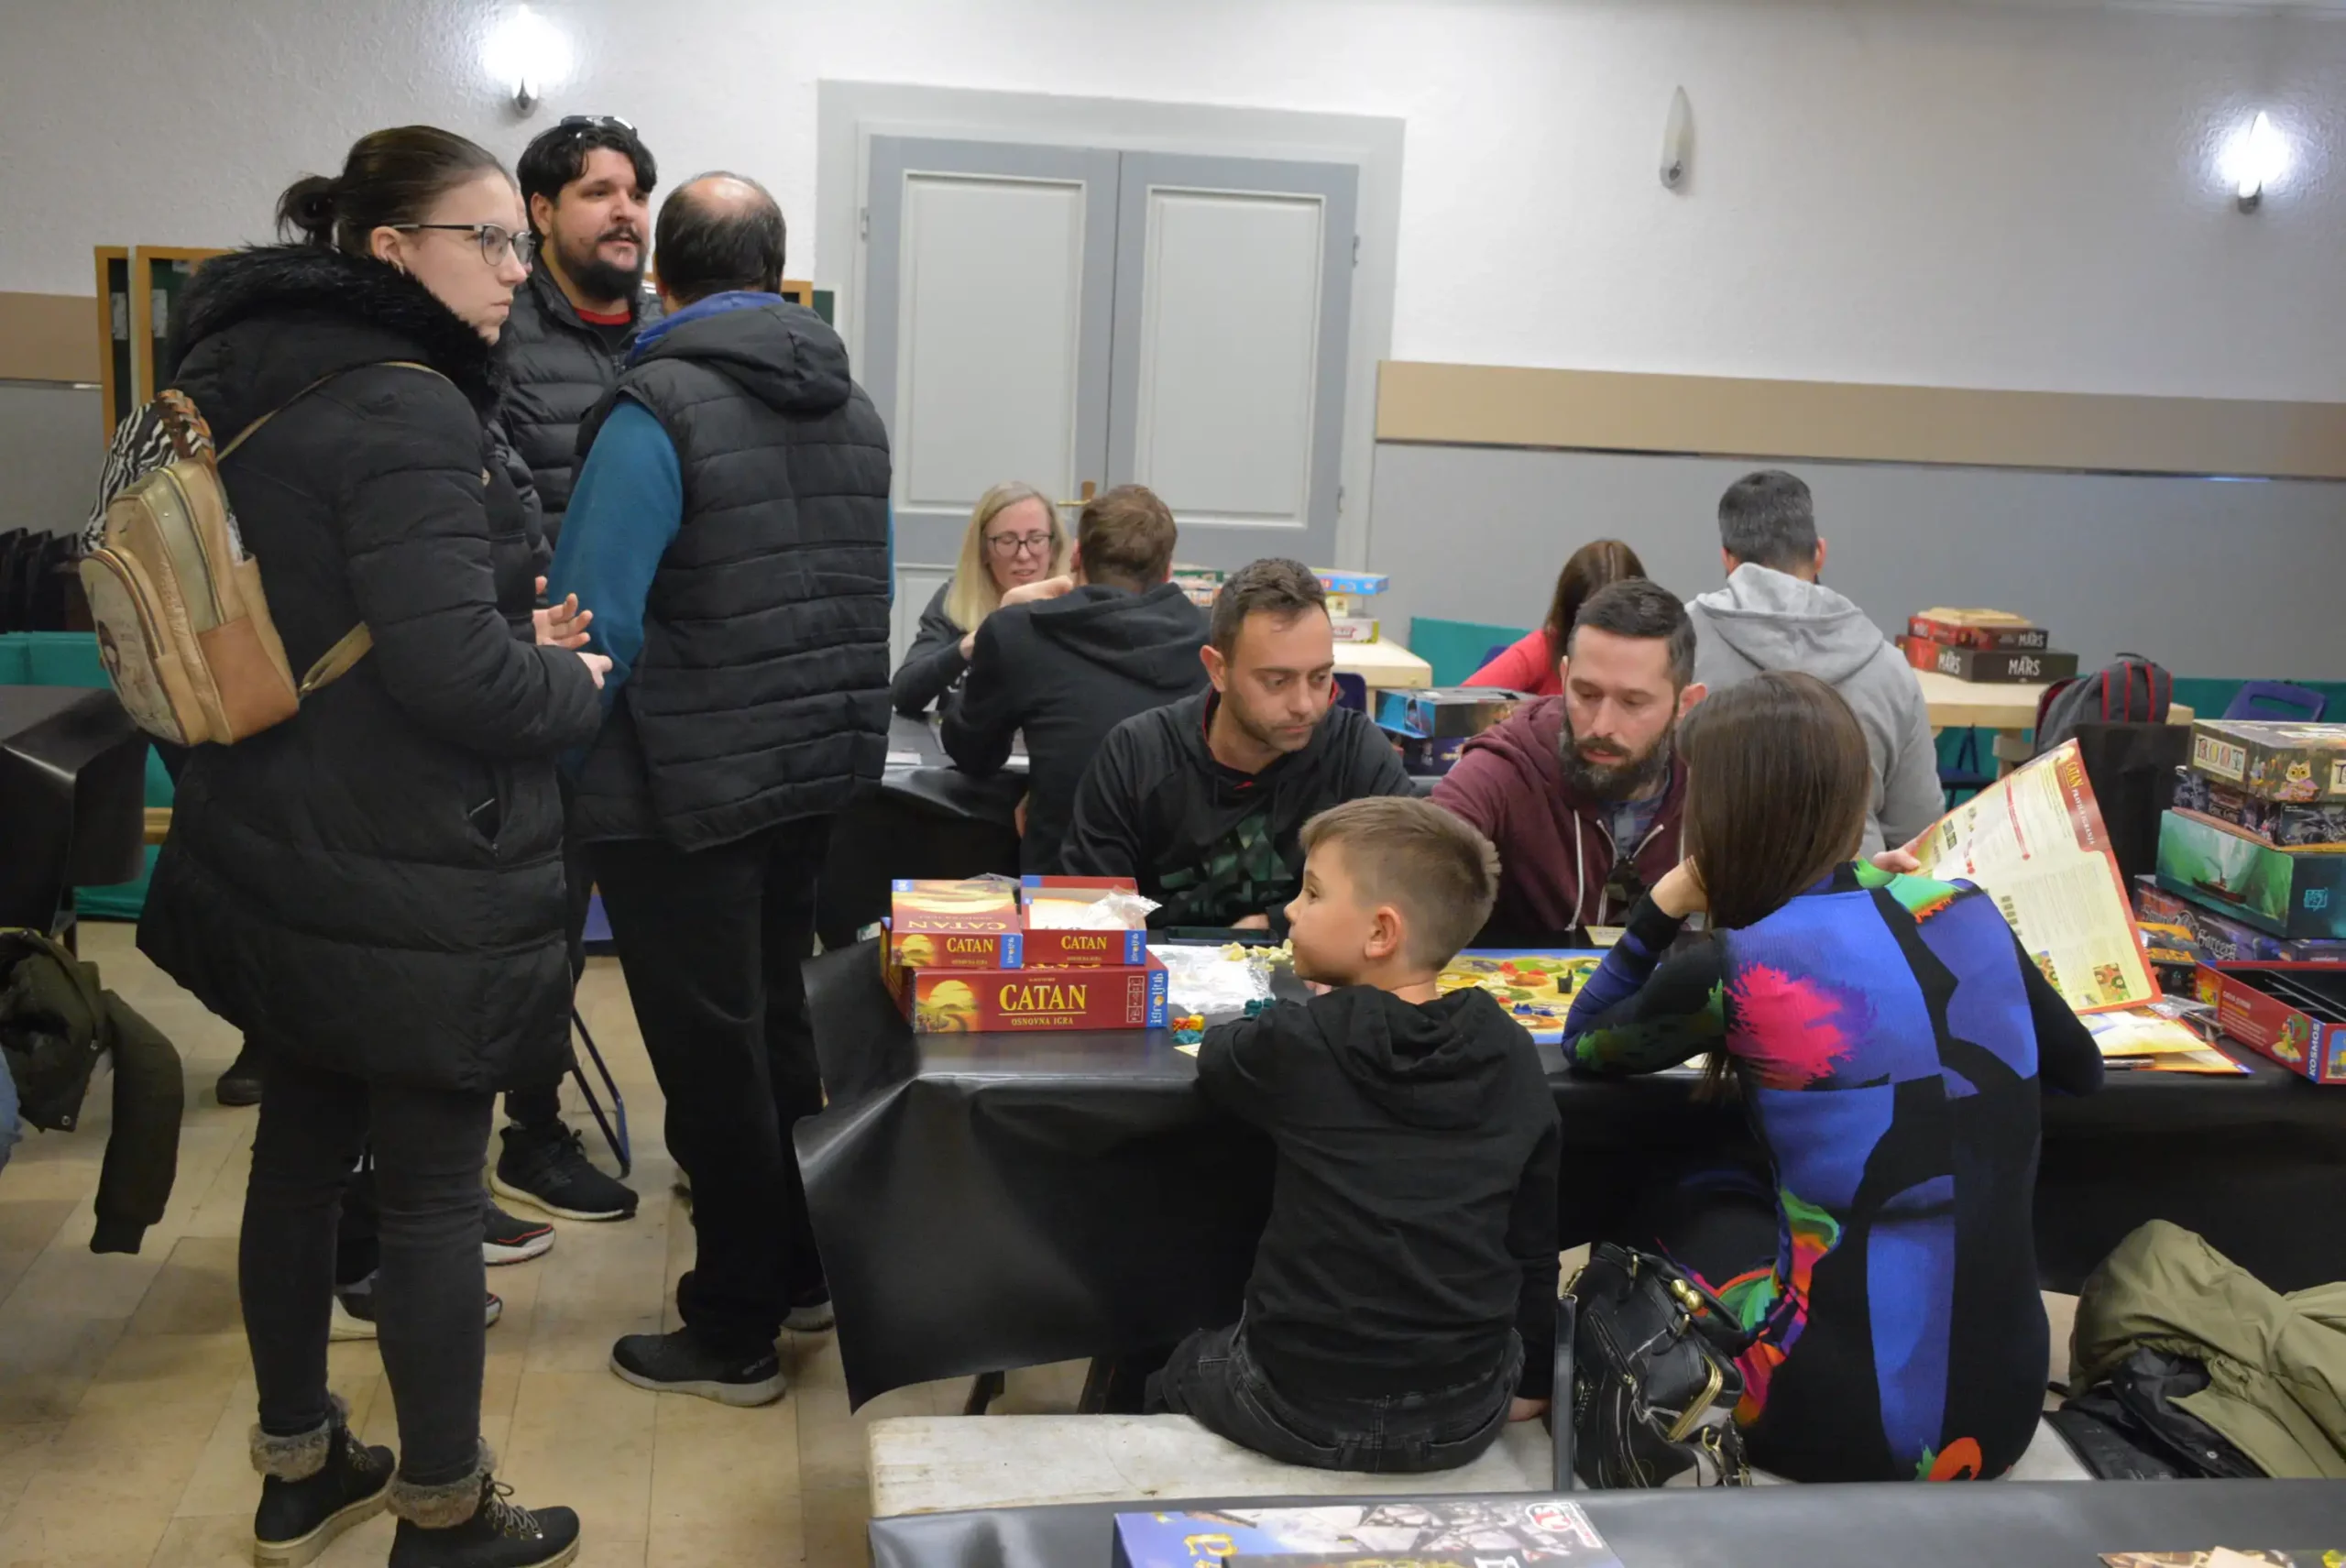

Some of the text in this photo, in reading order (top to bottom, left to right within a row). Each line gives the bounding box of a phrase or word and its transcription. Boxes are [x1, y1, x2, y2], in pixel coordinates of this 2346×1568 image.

[2008, 658, 2041, 676] MARS
[2066, 762, 2084, 788] CATAN
[907, 920, 1007, 930] CATAN
[946, 937, 993, 953] CATAN
[1060, 935, 1108, 950] CATAN
[998, 983, 1088, 1012] CATAN
[1011, 1016, 1074, 1026] OSNOVNA IGRA
[2308, 1023, 2320, 1077] KOSMOS
